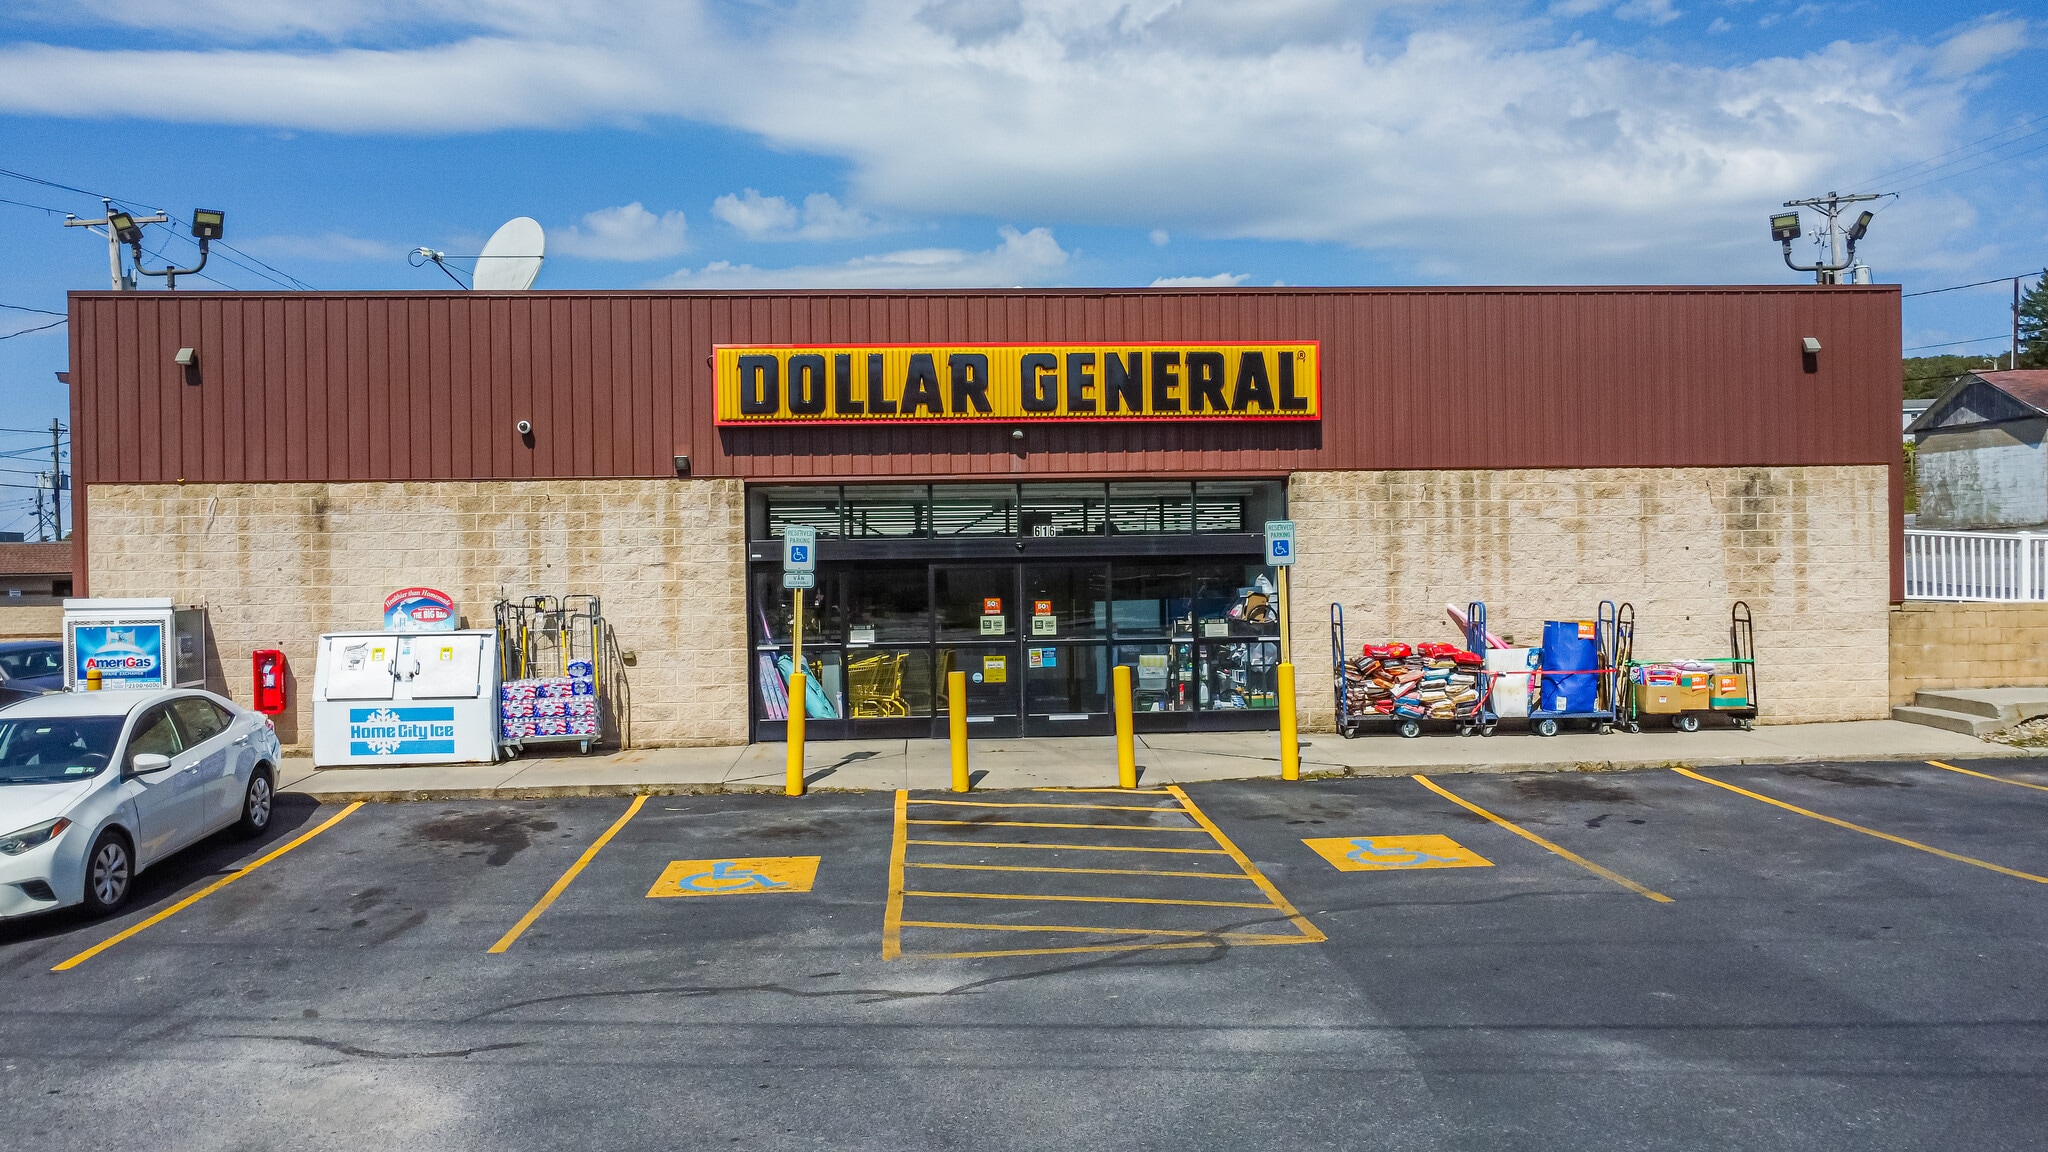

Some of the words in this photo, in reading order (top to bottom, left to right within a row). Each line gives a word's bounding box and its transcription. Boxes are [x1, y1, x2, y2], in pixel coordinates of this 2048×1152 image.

[737, 353, 993, 415] DOLLAR
[1020, 351, 1308, 412] GENERAL
[1034, 525, 1055, 537] 616
[421, 589, 451, 606] Homemade
[423, 610, 435, 619] BIG
[435, 611, 448, 619] BAG
[86, 656, 152, 668] AmeriGas
[350, 725, 396, 739] Home
[398, 724, 428, 740] City
[430, 723, 454, 737] Ice
